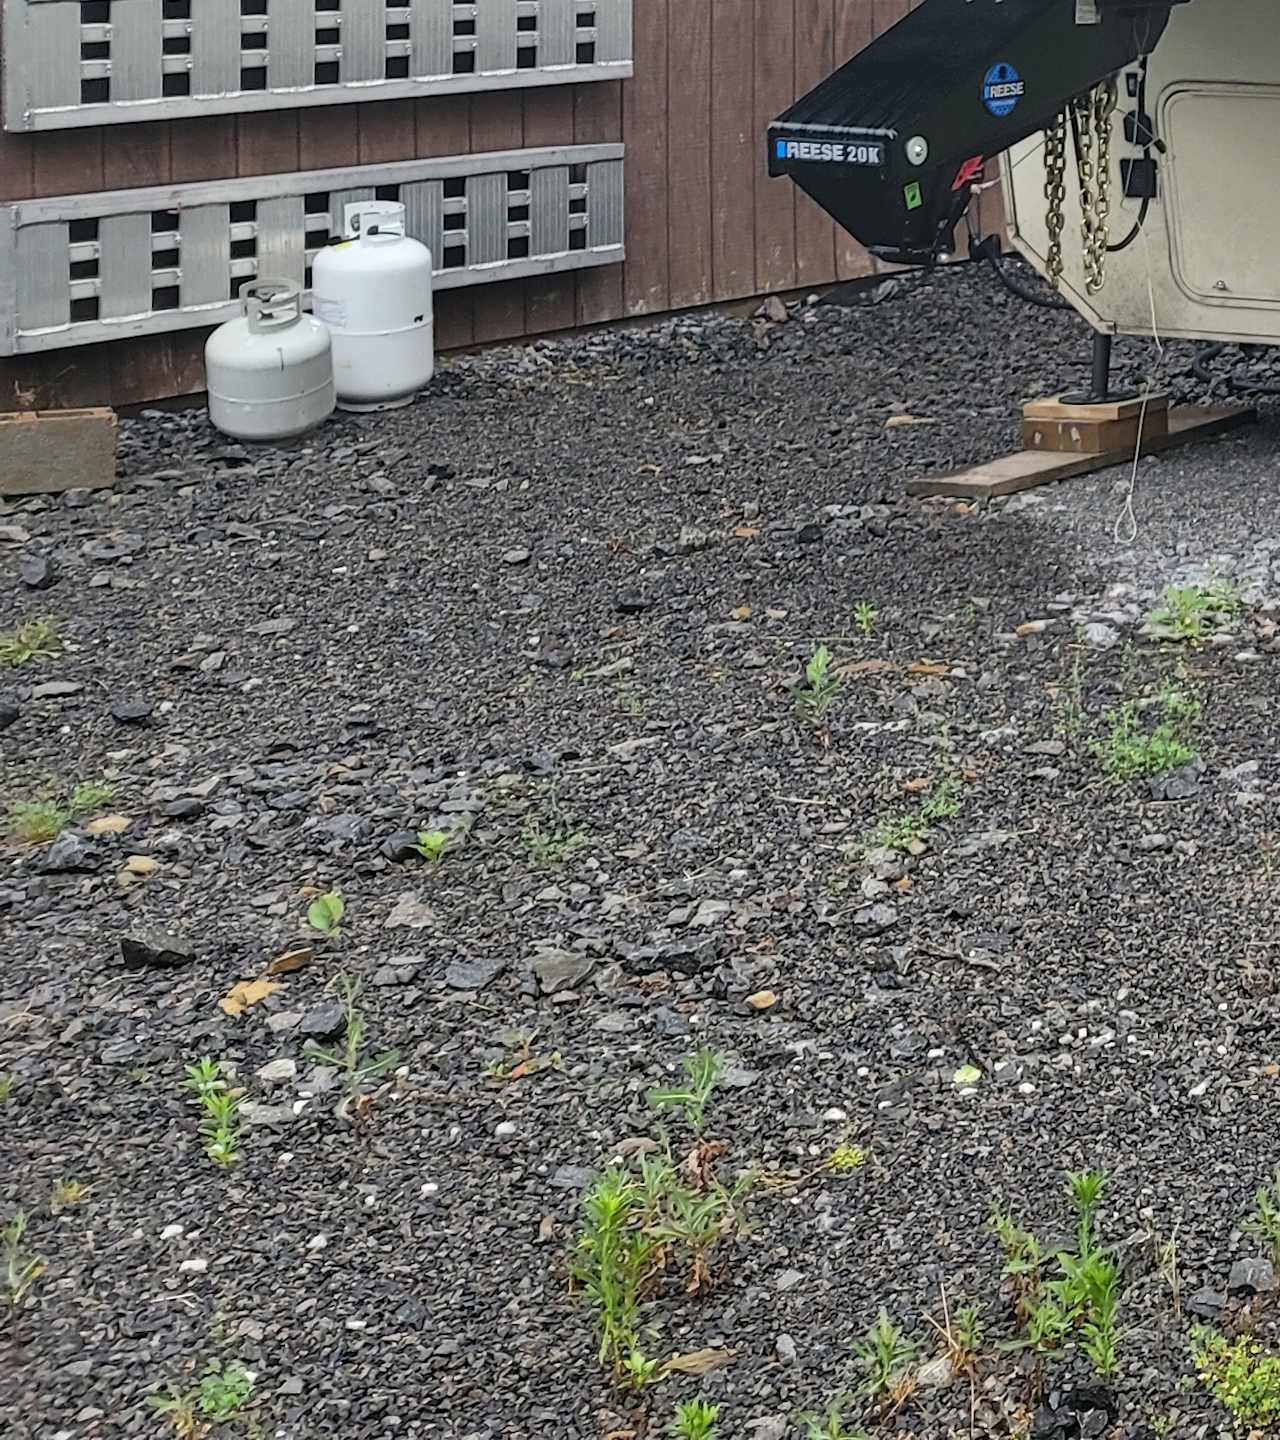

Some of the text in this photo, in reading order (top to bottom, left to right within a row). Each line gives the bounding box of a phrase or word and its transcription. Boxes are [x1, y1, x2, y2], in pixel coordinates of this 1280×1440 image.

[990, 81, 1025, 98] REESE
[786, 141, 880, 164] REESE 20K
